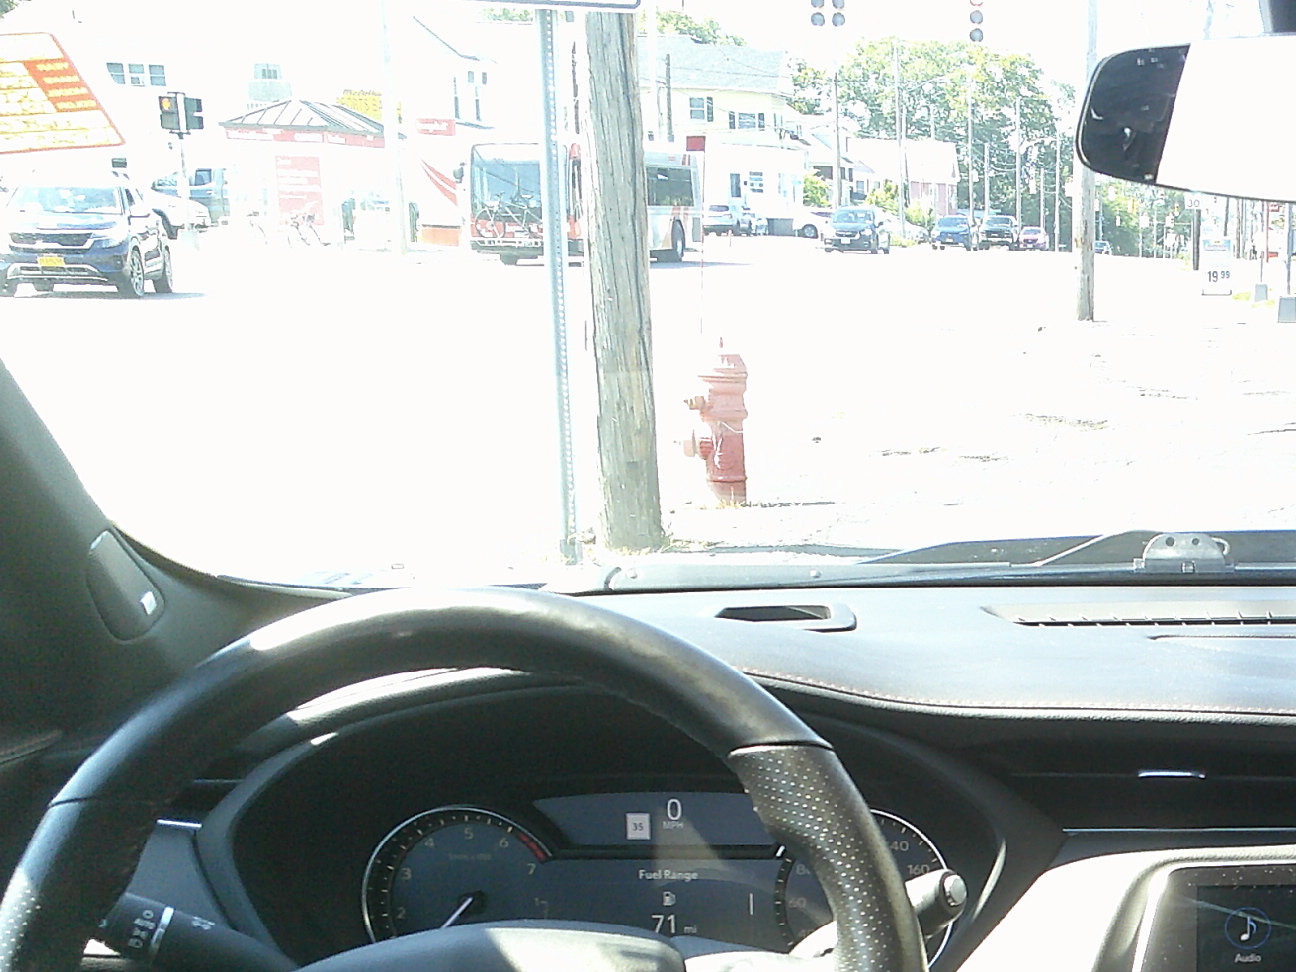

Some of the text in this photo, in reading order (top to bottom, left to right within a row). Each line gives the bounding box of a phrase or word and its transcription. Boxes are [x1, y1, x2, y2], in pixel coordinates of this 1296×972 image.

[1187, 199, 1200, 208] 30
[1207, 270, 1231, 283] 19 99
[667, 798, 682, 821] 0
[632, 822, 644, 831] 35
[663, 821, 684, 830] MPH
[463, 828, 474, 840] 5
[424, 837, 435, 848] 4
[499, 837, 509, 848] 6
[889, 840, 909, 851] 40
[402, 868, 412, 880] 3
[526, 863, 537, 875] 7
[907, 864, 930, 875] 160
[638, 869, 699, 881] Fuel Range
[652, 914, 697, 934] 71 mi
[1234, 953, 1262, 963] Audio
